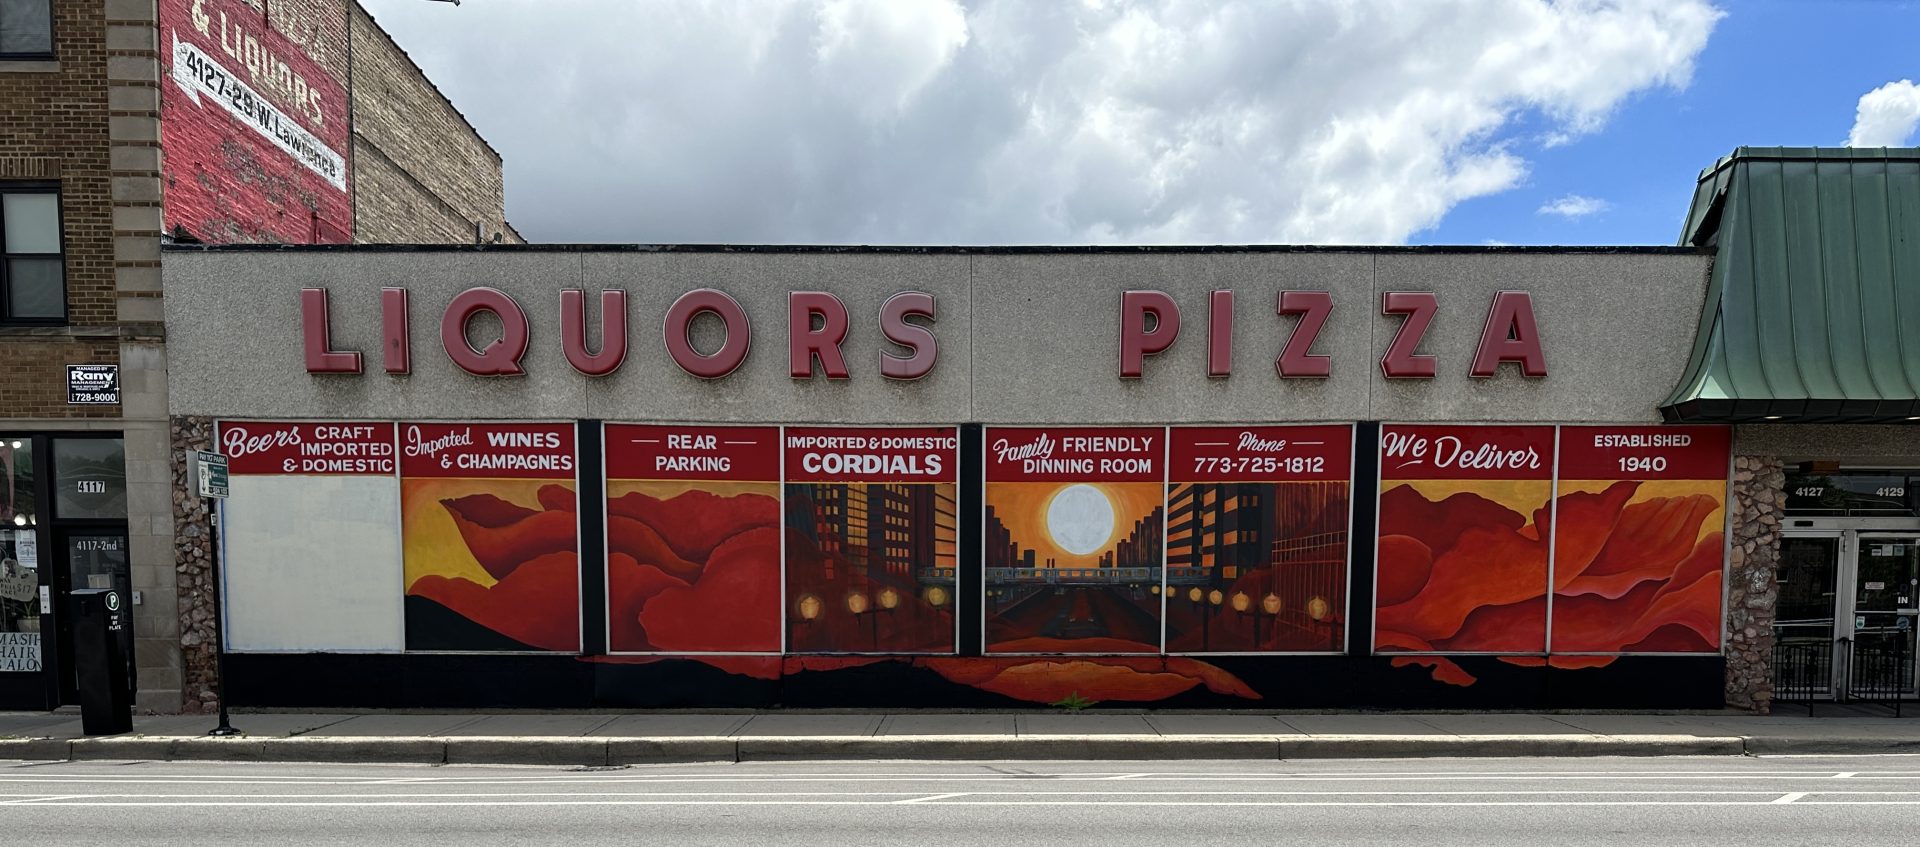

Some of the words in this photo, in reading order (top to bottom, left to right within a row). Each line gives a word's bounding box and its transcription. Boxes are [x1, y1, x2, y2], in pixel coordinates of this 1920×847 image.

[191, 0, 210, 40] &
[220, 10, 323, 125] LIQUORS
[186, 51, 253, 118] 4127-29
[300, 286, 940, 380] LIQUORS
[1118, 289, 1549, 379] PIZZA
[71, 370, 114, 388] Rany
[75, 393, 116, 402] 728-9000
[222, 427, 302, 458] Beers
[314, 426, 375, 440] CRAFT
[404, 425, 474, 458] Imported
[487, 432, 561, 448] WINES
[667, 434, 717, 450] REAR
[787, 436, 867, 449] IMPORTED
[868, 438, 880, 450] &
[881, 437, 956, 450] DOMESTIC
[992, 432, 1056, 463] Family
[1063, 437, 1153, 453] FRIENDLY
[1236, 431, 1287, 452] Phone
[1594, 434, 1691, 447] ESTABLISHED
[300, 442, 393, 457] IMPORTED
[1382, 431, 1428, 457] We
[1433, 436, 1541, 470] Deliver
[282, 458, 299, 472] &
[302, 458, 393, 472] DOMESTIC
[440, 454, 453, 469] &
[456, 454, 573, 471] CHAMPAGNES
[655, 456, 731, 472] PARKING
[802, 453, 942, 475] CORDIALS
[1023, 459, 1094, 474] DINNING
[1100, 459, 1152, 474] ROOM
[1194, 457, 1325, 473] 773-725-1812
[1618, 456, 1667, 472] 1940
[78, 481, 105, 493] 4117
[1795, 487, 1824, 497] 4127
[1876, 487, 1905, 497] 4129
[76, 540, 117, 551] 4117-2nd
[1897, 596, 1908, 604] IN
[0, 659, 42, 671] ALON
